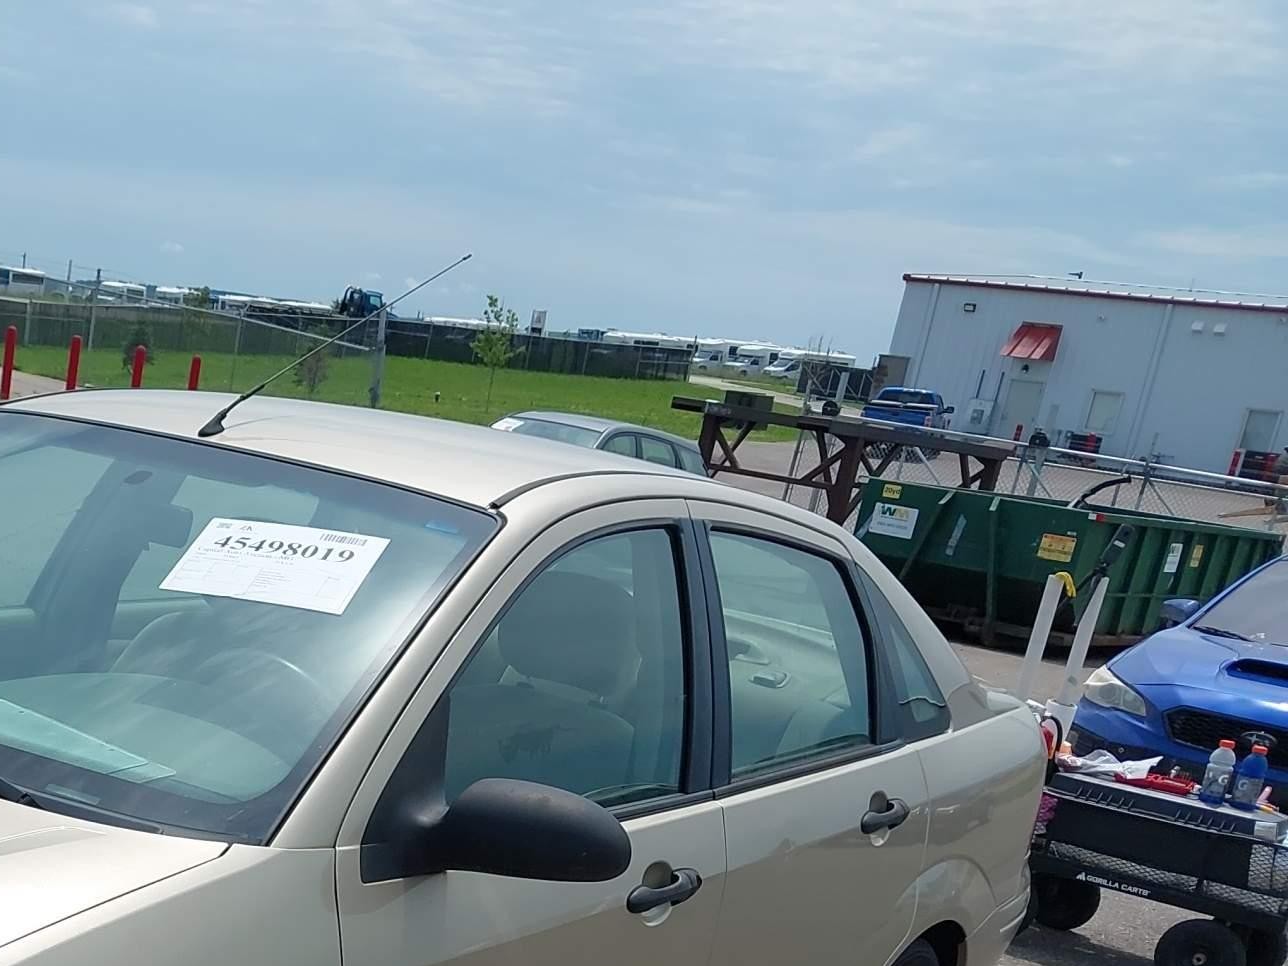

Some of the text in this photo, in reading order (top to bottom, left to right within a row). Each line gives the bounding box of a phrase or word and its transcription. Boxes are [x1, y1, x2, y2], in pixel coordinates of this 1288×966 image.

[880, 504, 910, 519] WM
[213, 535, 356, 563] 45498019
[1086, 875, 1119, 889] GORILLA
